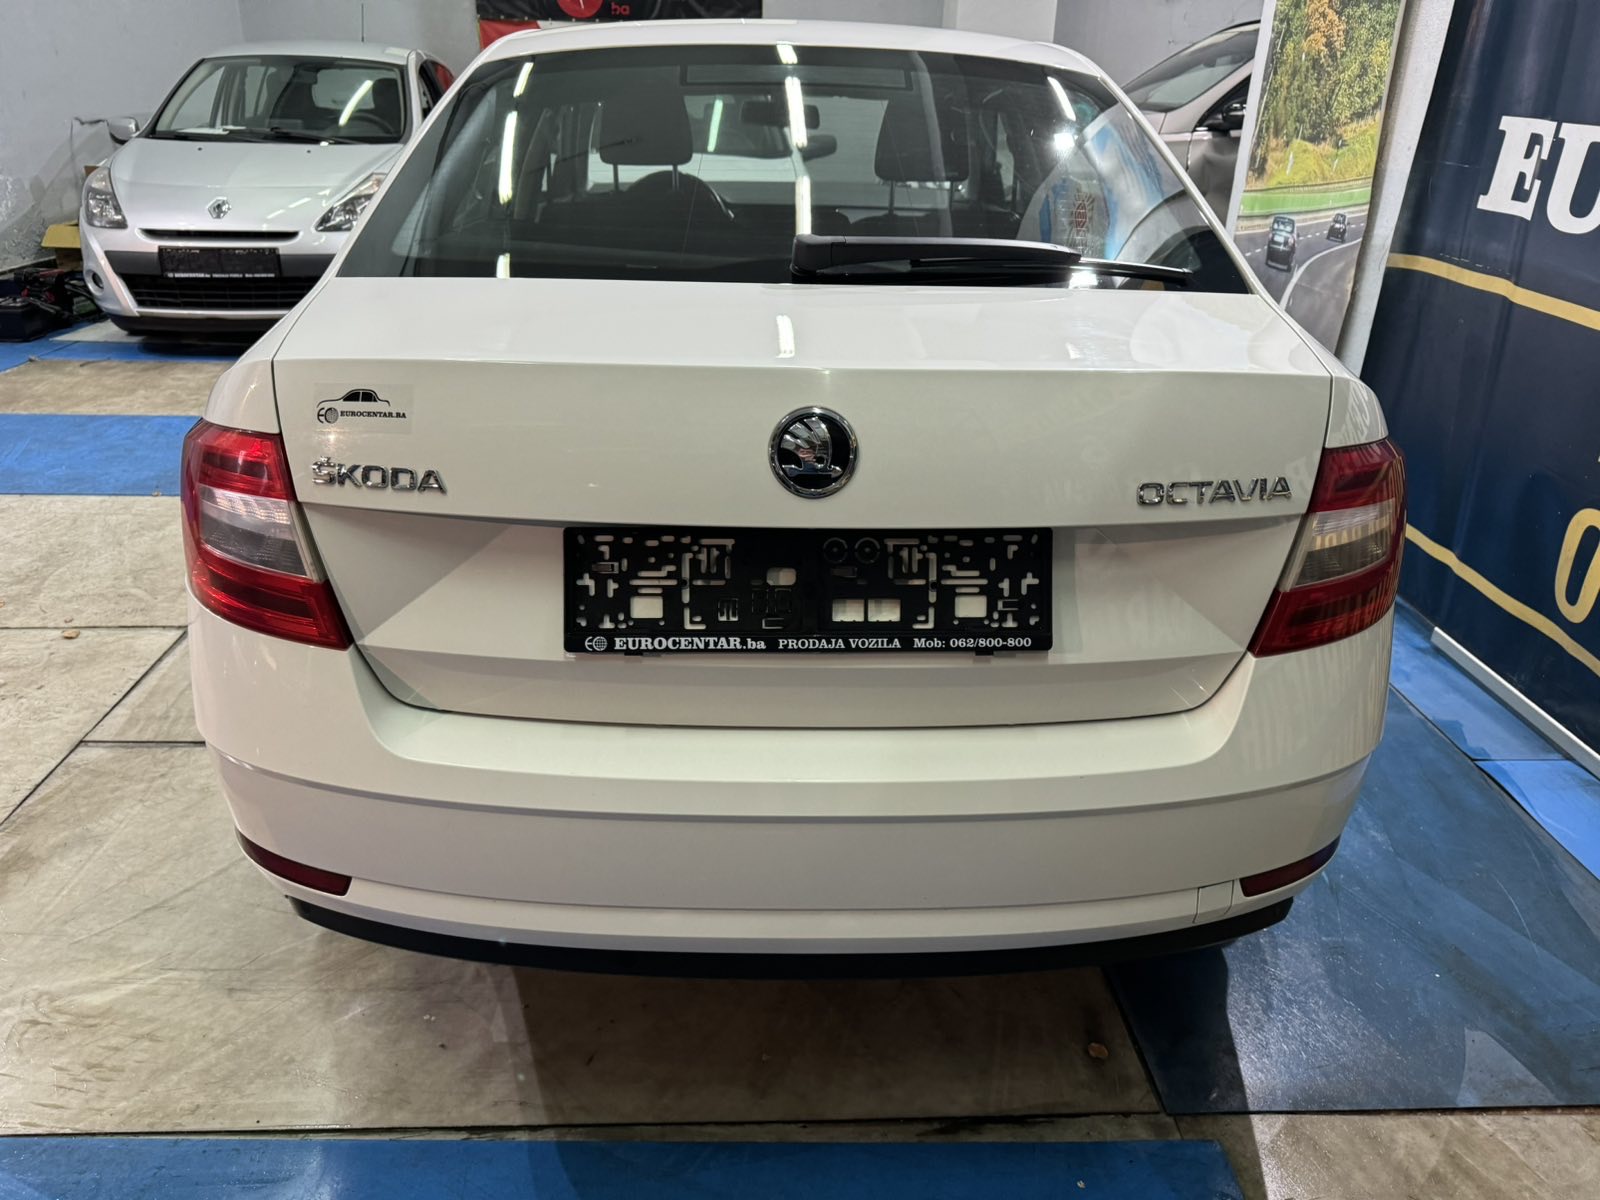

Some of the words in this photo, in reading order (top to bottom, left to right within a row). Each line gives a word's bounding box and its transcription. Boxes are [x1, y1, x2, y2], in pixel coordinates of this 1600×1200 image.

[340, 410, 407, 419] EUROCENTAR.BA
[311, 455, 447, 494] ŠKODA
[1136, 476, 1293, 506] OCTAVIA
[613, 637, 767, 650] EUROCENTAR.ba
[777, 638, 845, 650] PRODAJA
[849, 638, 902, 649] VOZILA
[913, 637, 946, 649] Mob:
[949, 637, 1032, 648] 062/800-800
